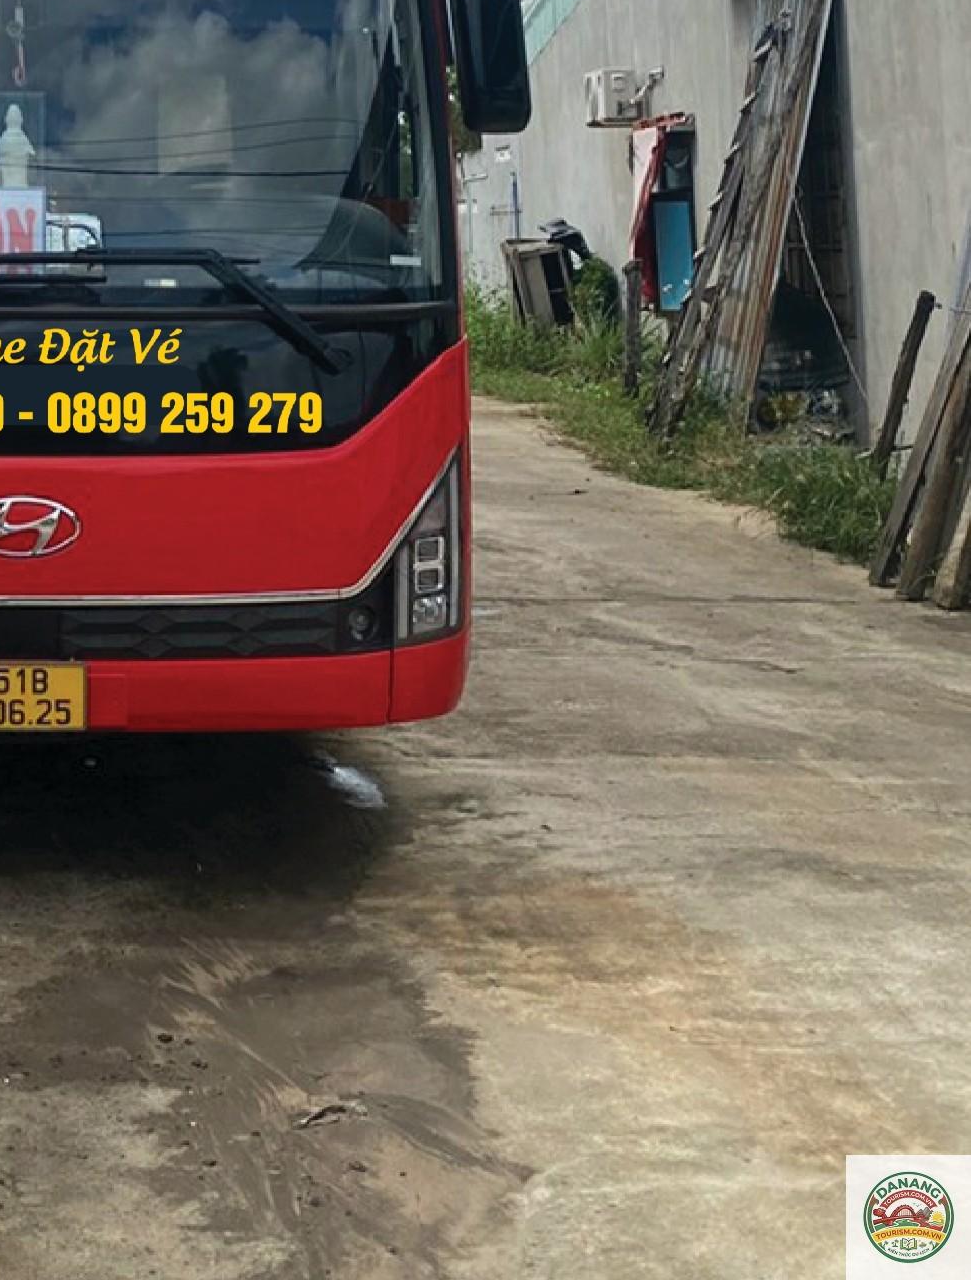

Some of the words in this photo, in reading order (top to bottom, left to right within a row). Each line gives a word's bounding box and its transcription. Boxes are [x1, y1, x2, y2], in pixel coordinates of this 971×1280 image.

[38, 328, 116, 372] Đặt
[130, 328, 182, 366] Vé
[47, 391, 146, 434] 0899
[160, 391, 234, 434] 259
[247, 391, 322, 434] 279
